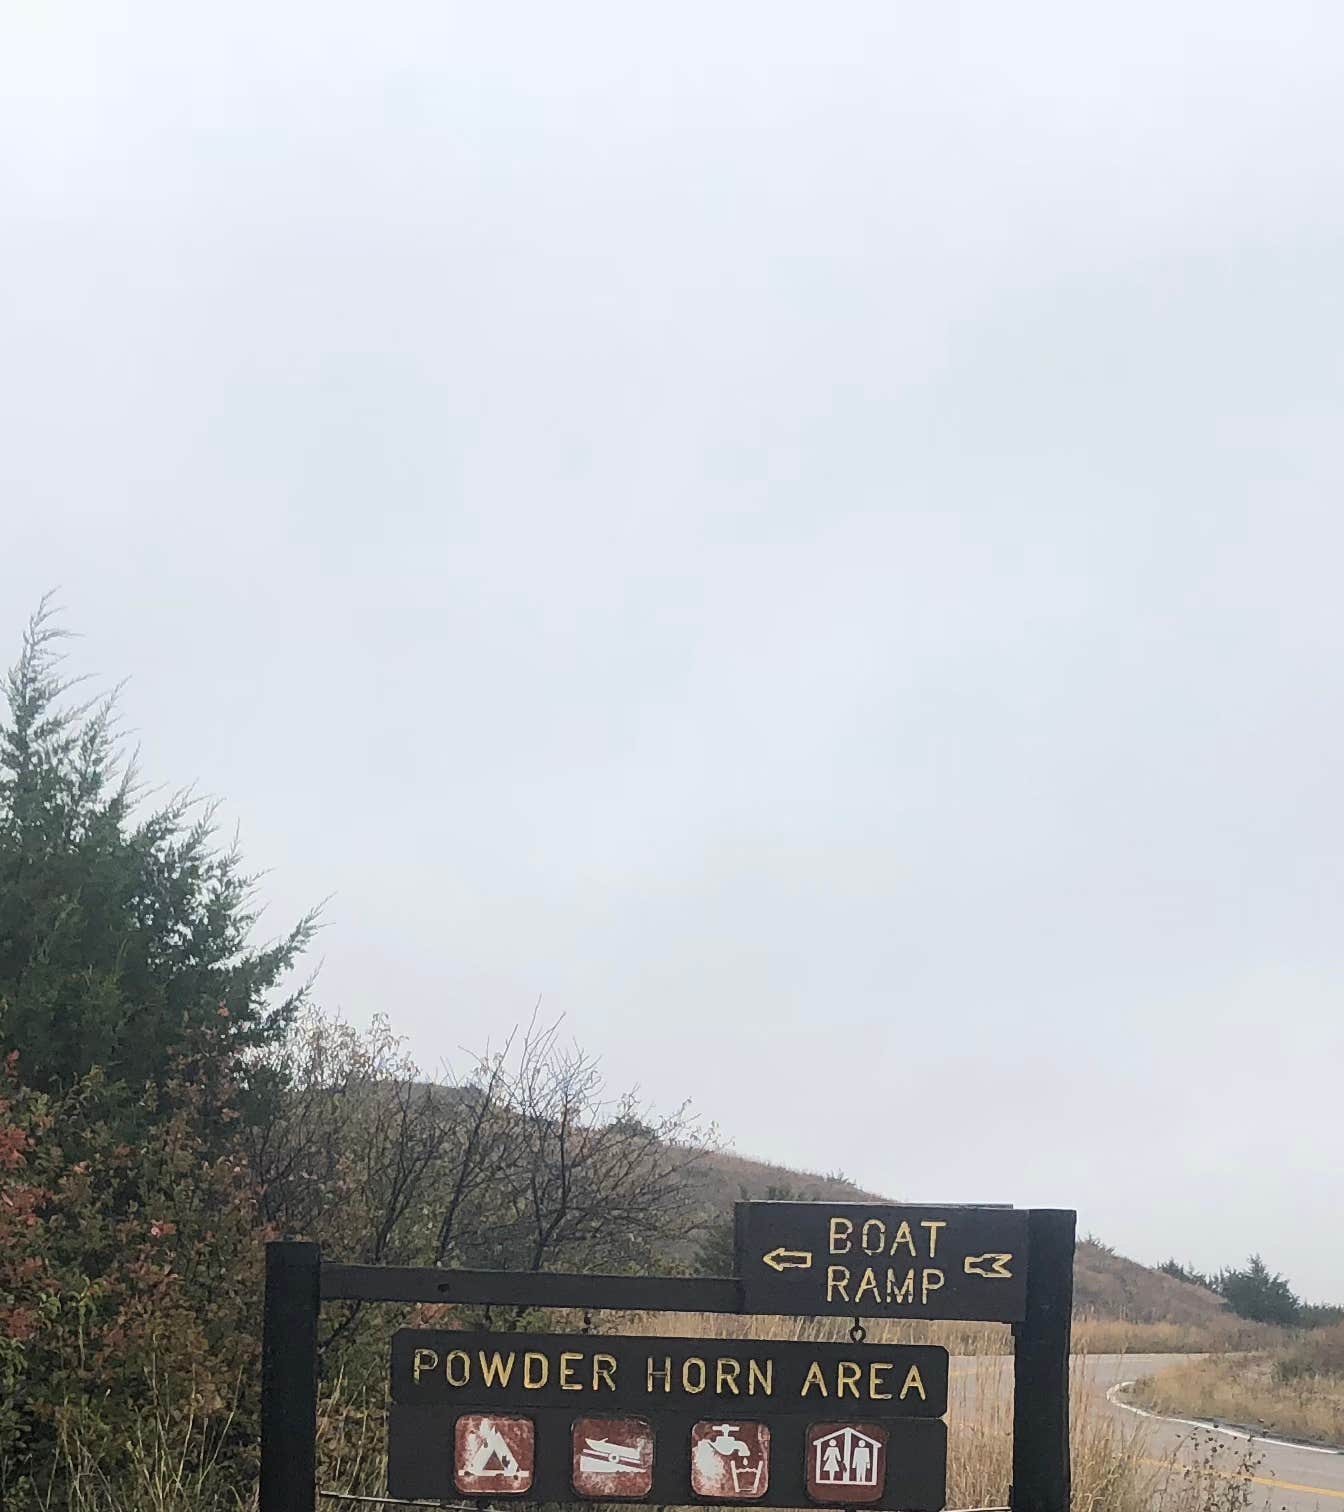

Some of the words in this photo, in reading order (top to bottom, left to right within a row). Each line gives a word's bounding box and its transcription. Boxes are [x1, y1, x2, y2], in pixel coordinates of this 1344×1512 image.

[827, 1217, 948, 1257] BOAT
[826, 1265, 946, 1306] RAMP
[412, 1348, 618, 1393] POWDER
[645, 1356, 774, 1397] HORN
[800, 1361, 927, 1401] AREA
